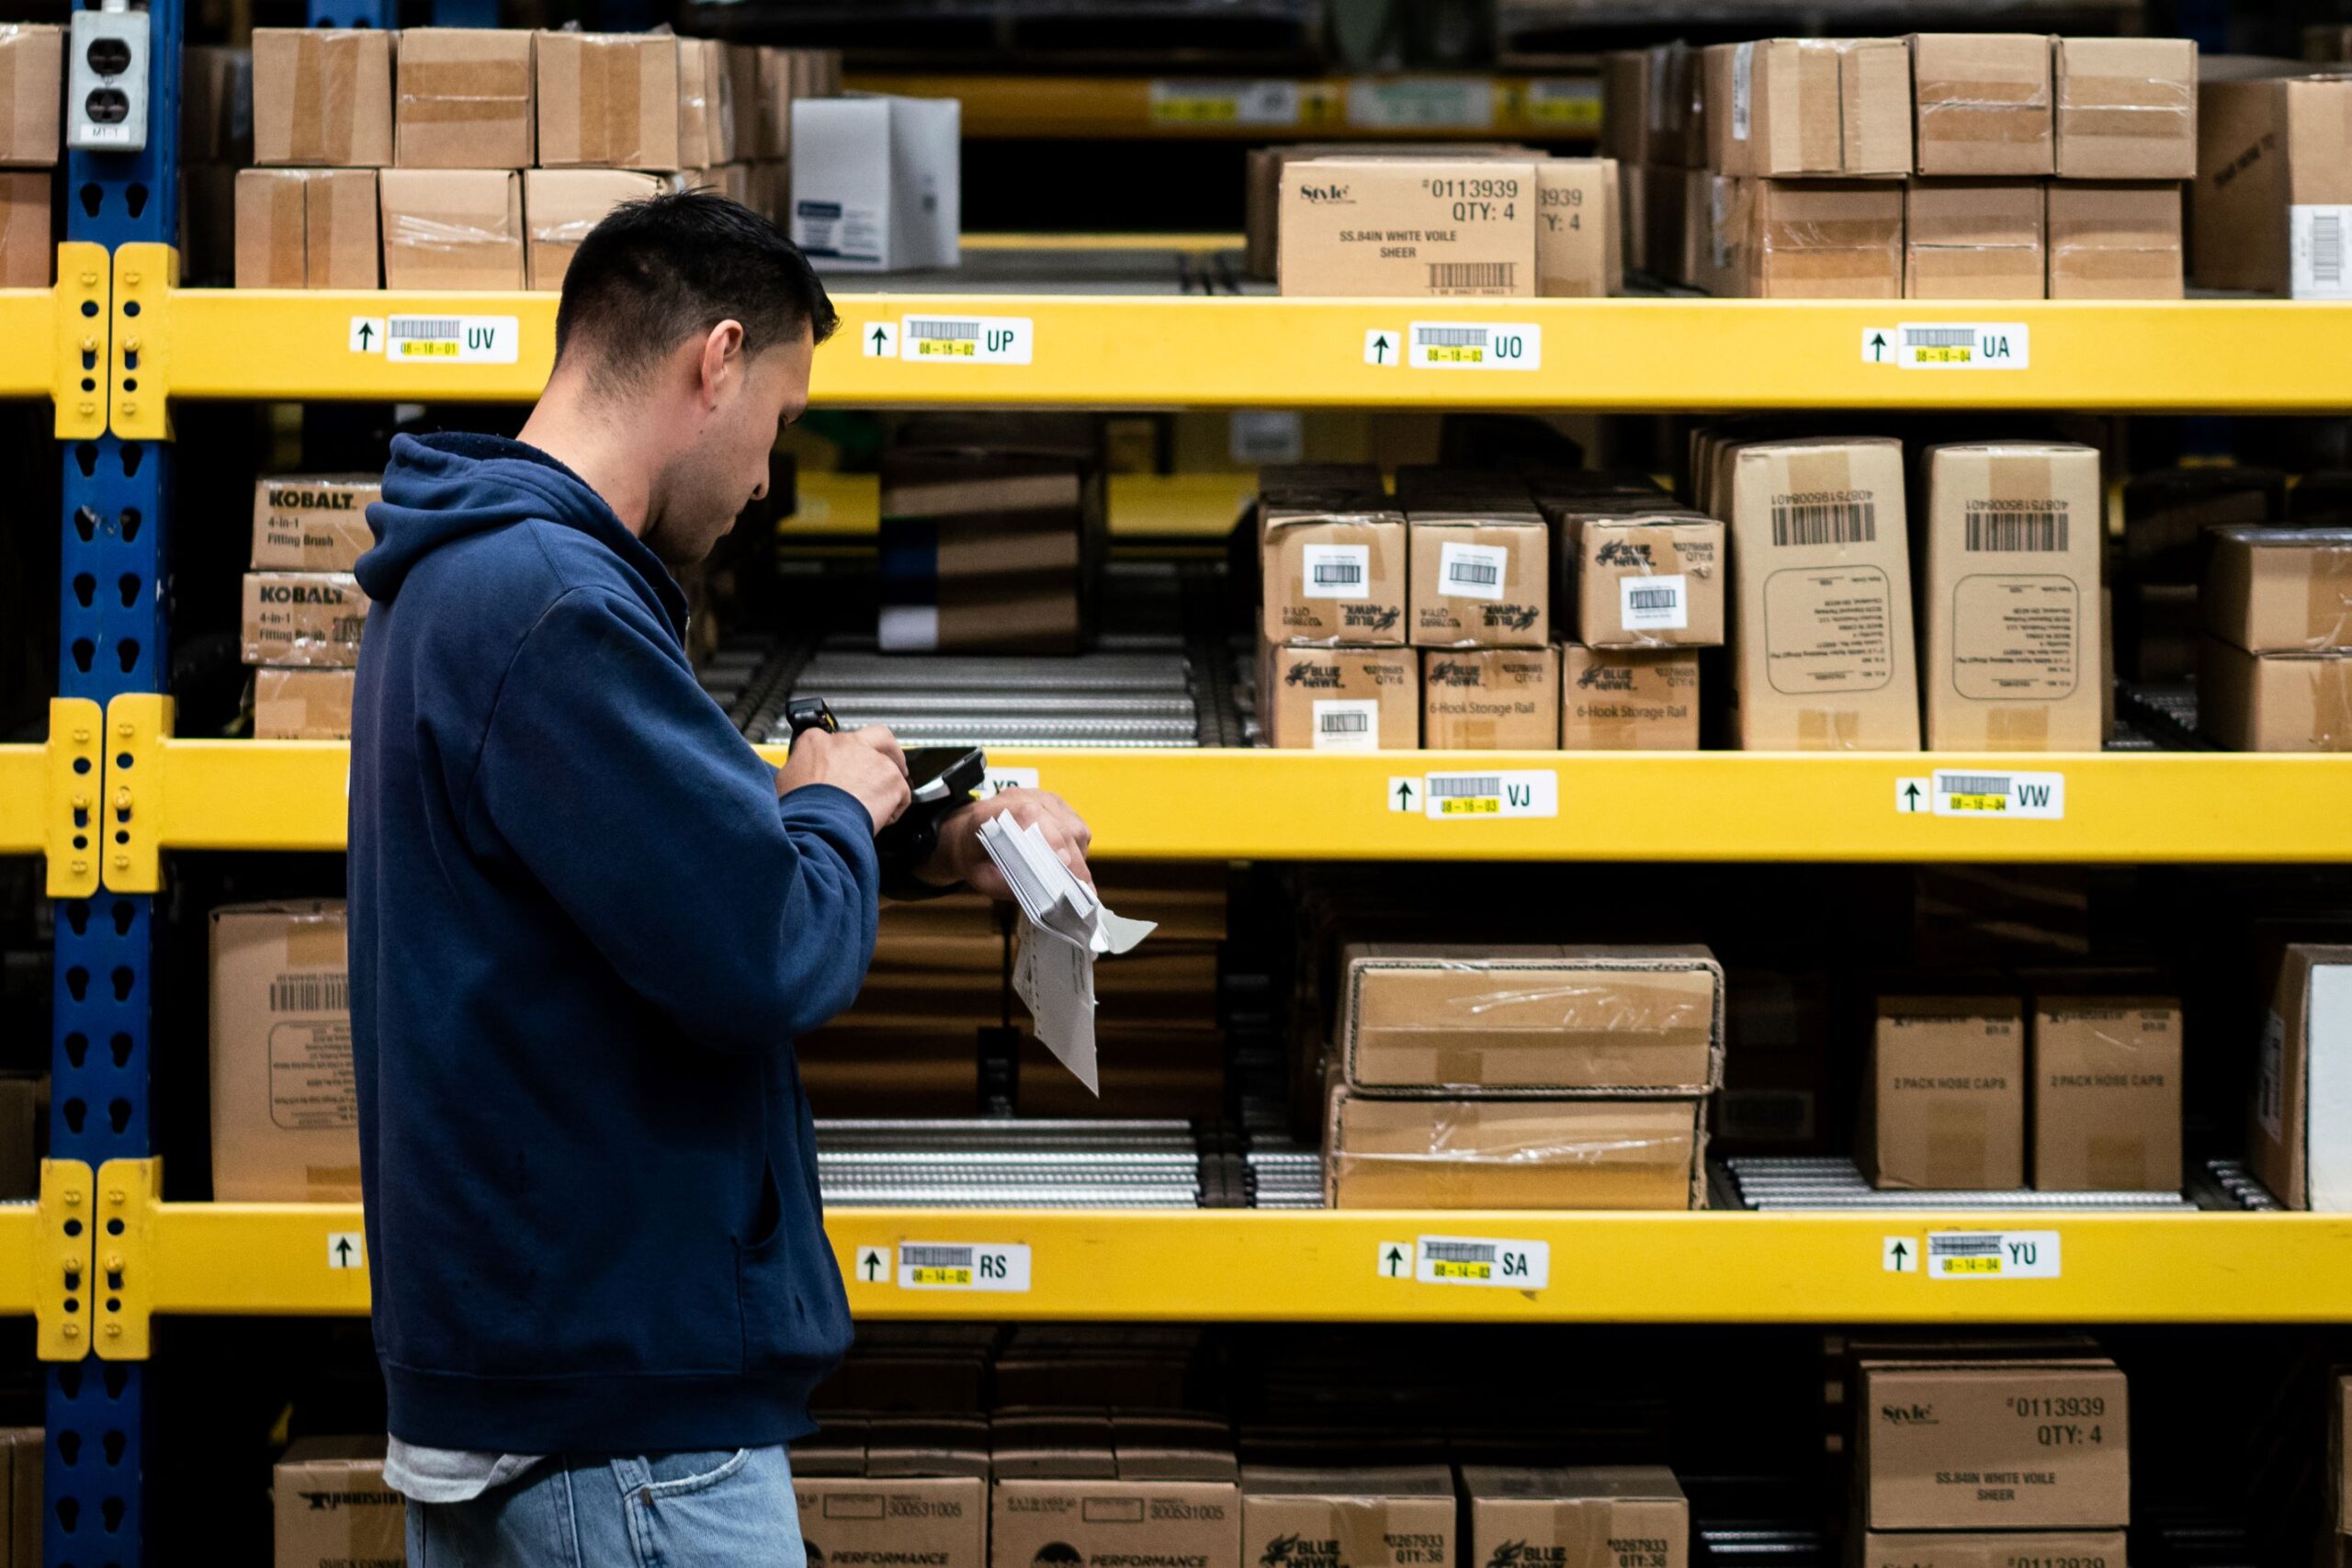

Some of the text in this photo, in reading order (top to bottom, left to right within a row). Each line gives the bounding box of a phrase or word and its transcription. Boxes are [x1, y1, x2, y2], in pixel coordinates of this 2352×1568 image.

[1453, 201, 1514, 221] QTY: 4
[1570, 214, 1580, 231] 4
[1386, 231, 1421, 242] WHITE
[1425, 231, 1456, 242] VOILE
[1380, 247, 1417, 259] SHEER
[468, 328, 495, 350] UV
[988, 330, 1014, 353] UP
[1983, 336, 2010, 358] UA
[269, 490, 354, 510] KOBALT
[267, 516, 300, 529] 4-in-1
[267, 533, 334, 548] Fitting Brush
[260, 586, 344, 605] KOBALT
[1345, 604, 1383, 615] HAWK
[259, 613, 291, 624] 4-in-1
[1345, 615, 1374, 626] BLUE
[1484, 615, 1514, 626] BLUE
[259, 628, 292, 643] Fitting
[1310, 666, 1340, 677] BLUE
[1302, 677, 1341, 688] HAWK
[1430, 701, 1535, 716] 6-Hook Storage Rail
[1577, 705, 1688, 721] 6-Hook Storage Rail
[1508, 784, 1531, 807] VJ
[2018, 784, 2050, 807] VW
[1903, 1077, 1935, 1089] PACK
[1938, 1077, 1970, 1089] HOSE
[1973, 1077, 2007, 1089] CAPS
[2060, 1075, 2092, 1087] PACK
[2095, 1075, 2128, 1087] HOSE
[2132, 1075, 2165, 1087] CAPS
[2008, 1242, 2036, 1265] YU
[980, 1254, 1007, 1279] RS
[1502, 1252, 1528, 1277] SA
[2038, 1426, 2102, 1446] QTY: 4
[1984, 1472, 2019, 1484] WHITE
[2023, 1472, 2055, 1484] VOILE
[1977, 1489, 2015, 1501] SHEER
[1297, 1540, 1340, 1555] BLUE
[1523, 1547, 1567, 1562] BLUE
[831, 1551, 950, 1565] PERFORMANCE
[1090, 1553, 1208, 1568] PERFORMANCE
